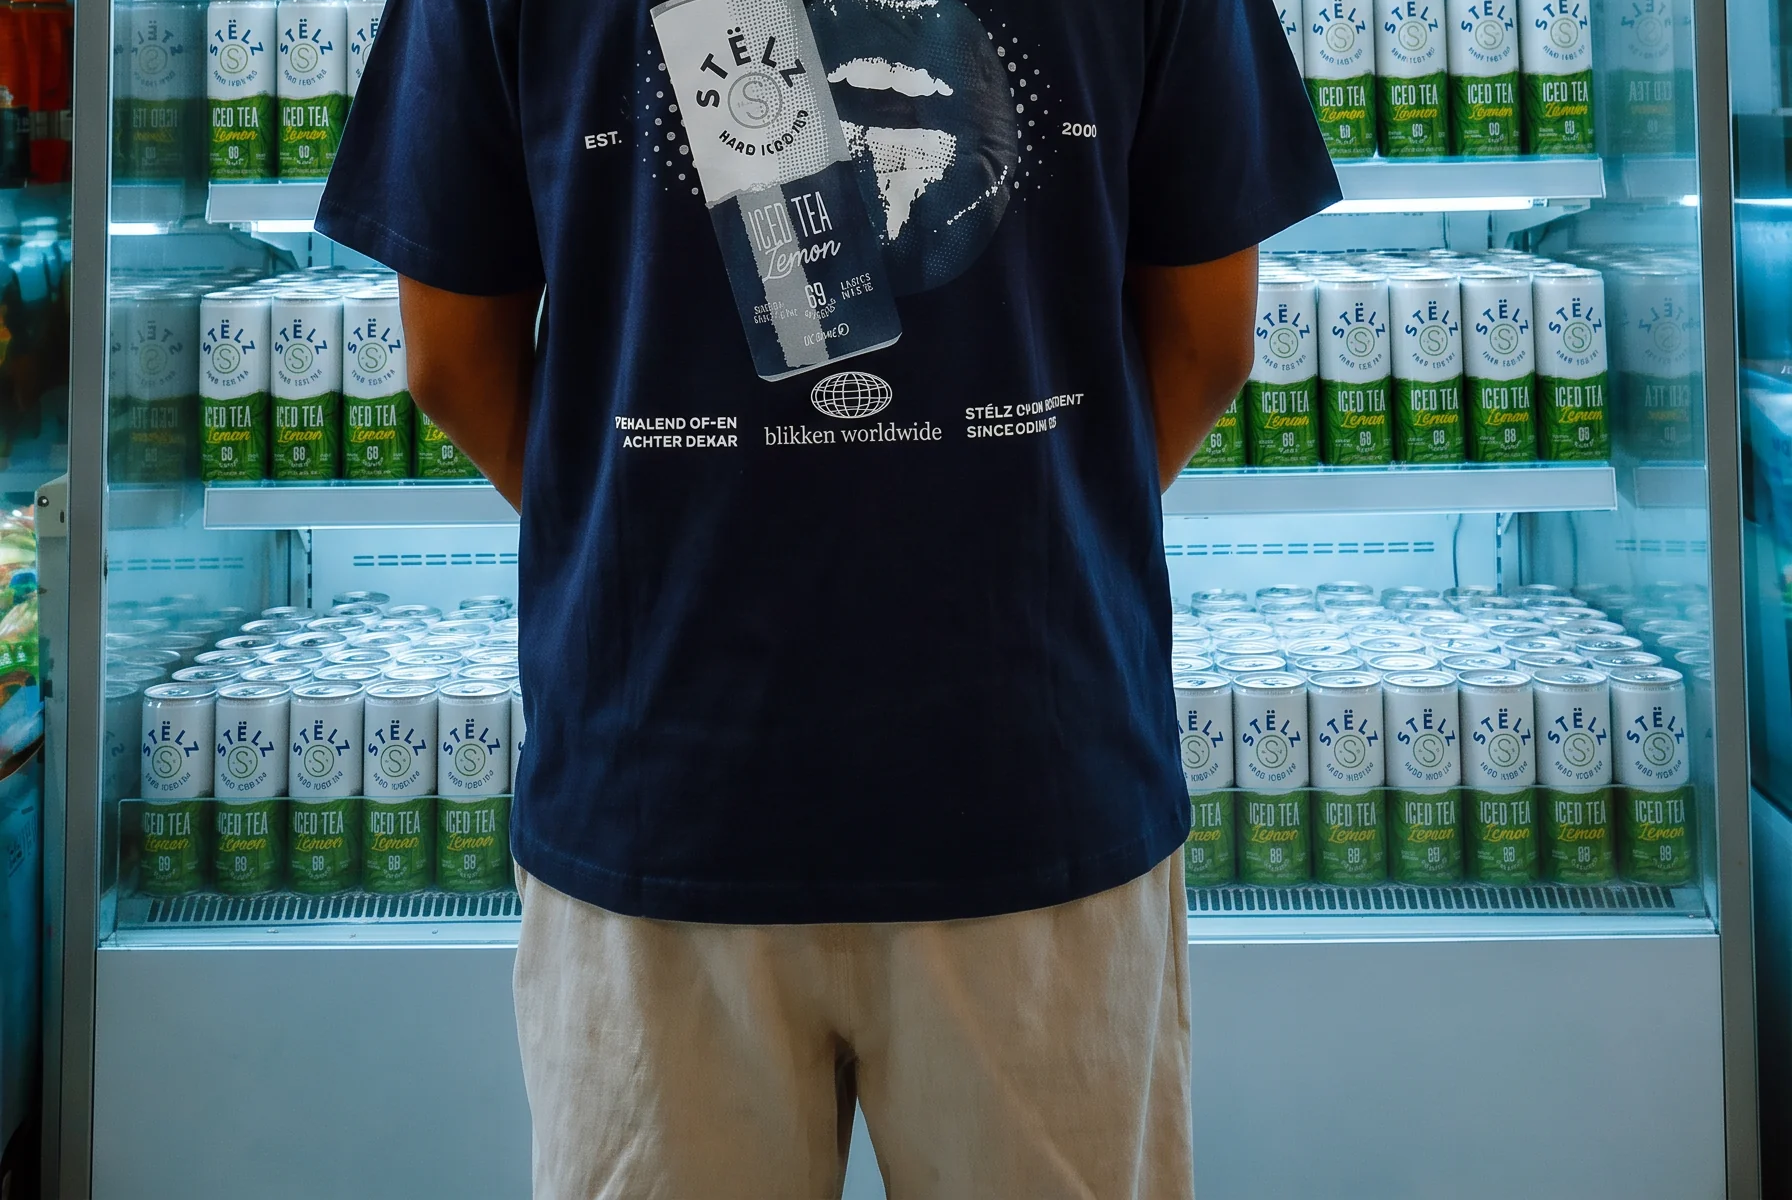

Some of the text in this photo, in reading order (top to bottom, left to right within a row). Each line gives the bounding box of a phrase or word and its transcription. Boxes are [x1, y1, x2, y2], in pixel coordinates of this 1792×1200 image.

[1313, 0, 1366, 35] STËLZ
[210, 20, 263, 56] STËLZ
[280, 19, 333, 55] STËLZ
[696, 26, 807, 109] STËLZ
[1347, 86, 1365, 106] TEA
[1419, 84, 1438, 104] TEA
[1495, 84, 1513, 103] TEA
[1570, 82, 1588, 101] TEA
[238, 107, 258, 127] TEA
[1061, 122, 1097, 138] 2000
[584, 131, 622, 150] EST.
[719, 130, 756, 156] HARD
[747, 191, 833, 251] ICED TEA
[761, 239, 841, 283] Lemon
[804, 281, 826, 309] 69
[1257, 304, 1310, 339] STËLZ
[1332, 303, 1385, 338] STËLZ
[1405, 301, 1458, 336] STËLZ
[1476, 299, 1528, 335] STËLZ
[1549, 298, 1602, 334] STËLZ
[203, 320, 255, 354] STËLZ
[275, 320, 327, 354] STËLZ
[348, 319, 401, 354] STËLZ
[965, 403, 1013, 420] STÉLZ
[1290, 391, 1309, 412] TEA
[1367, 390, 1385, 411] TEA
[1440, 388, 1458, 409] TEA
[1511, 387, 1529, 408] TEA
[1585, 385, 1603, 406] TEA
[690, 416, 737, 430] OF-EN
[764, 421, 942, 446] blikken worldwide
[623, 435, 682, 448] ACHTER
[143, 721, 199, 757] STËLZ
[217, 721, 274, 757] STËLZ
[293, 720, 350, 756] STËLZ
[368, 720, 426, 756] STËLZ
[443, 719, 500, 755] STËLZ
[1243, 710, 1301, 747] STËLZ
[1319, 709, 1378, 747] STËLZ
[1398, 709, 1455, 746] STËLZ
[1473, 708, 1531, 745] STËLZ
[1548, 707, 1606, 744] STËLZ
[1627, 707, 1684, 744] STËLZ
[398, 811, 420, 834] TEA
[474, 809, 495, 832] TEA
[1278, 801, 1299, 826] TEA
[1356, 801, 1376, 825] TEA
[1511, 801, 1531, 824] TEA
[1586, 800, 1606, 824] TEA
